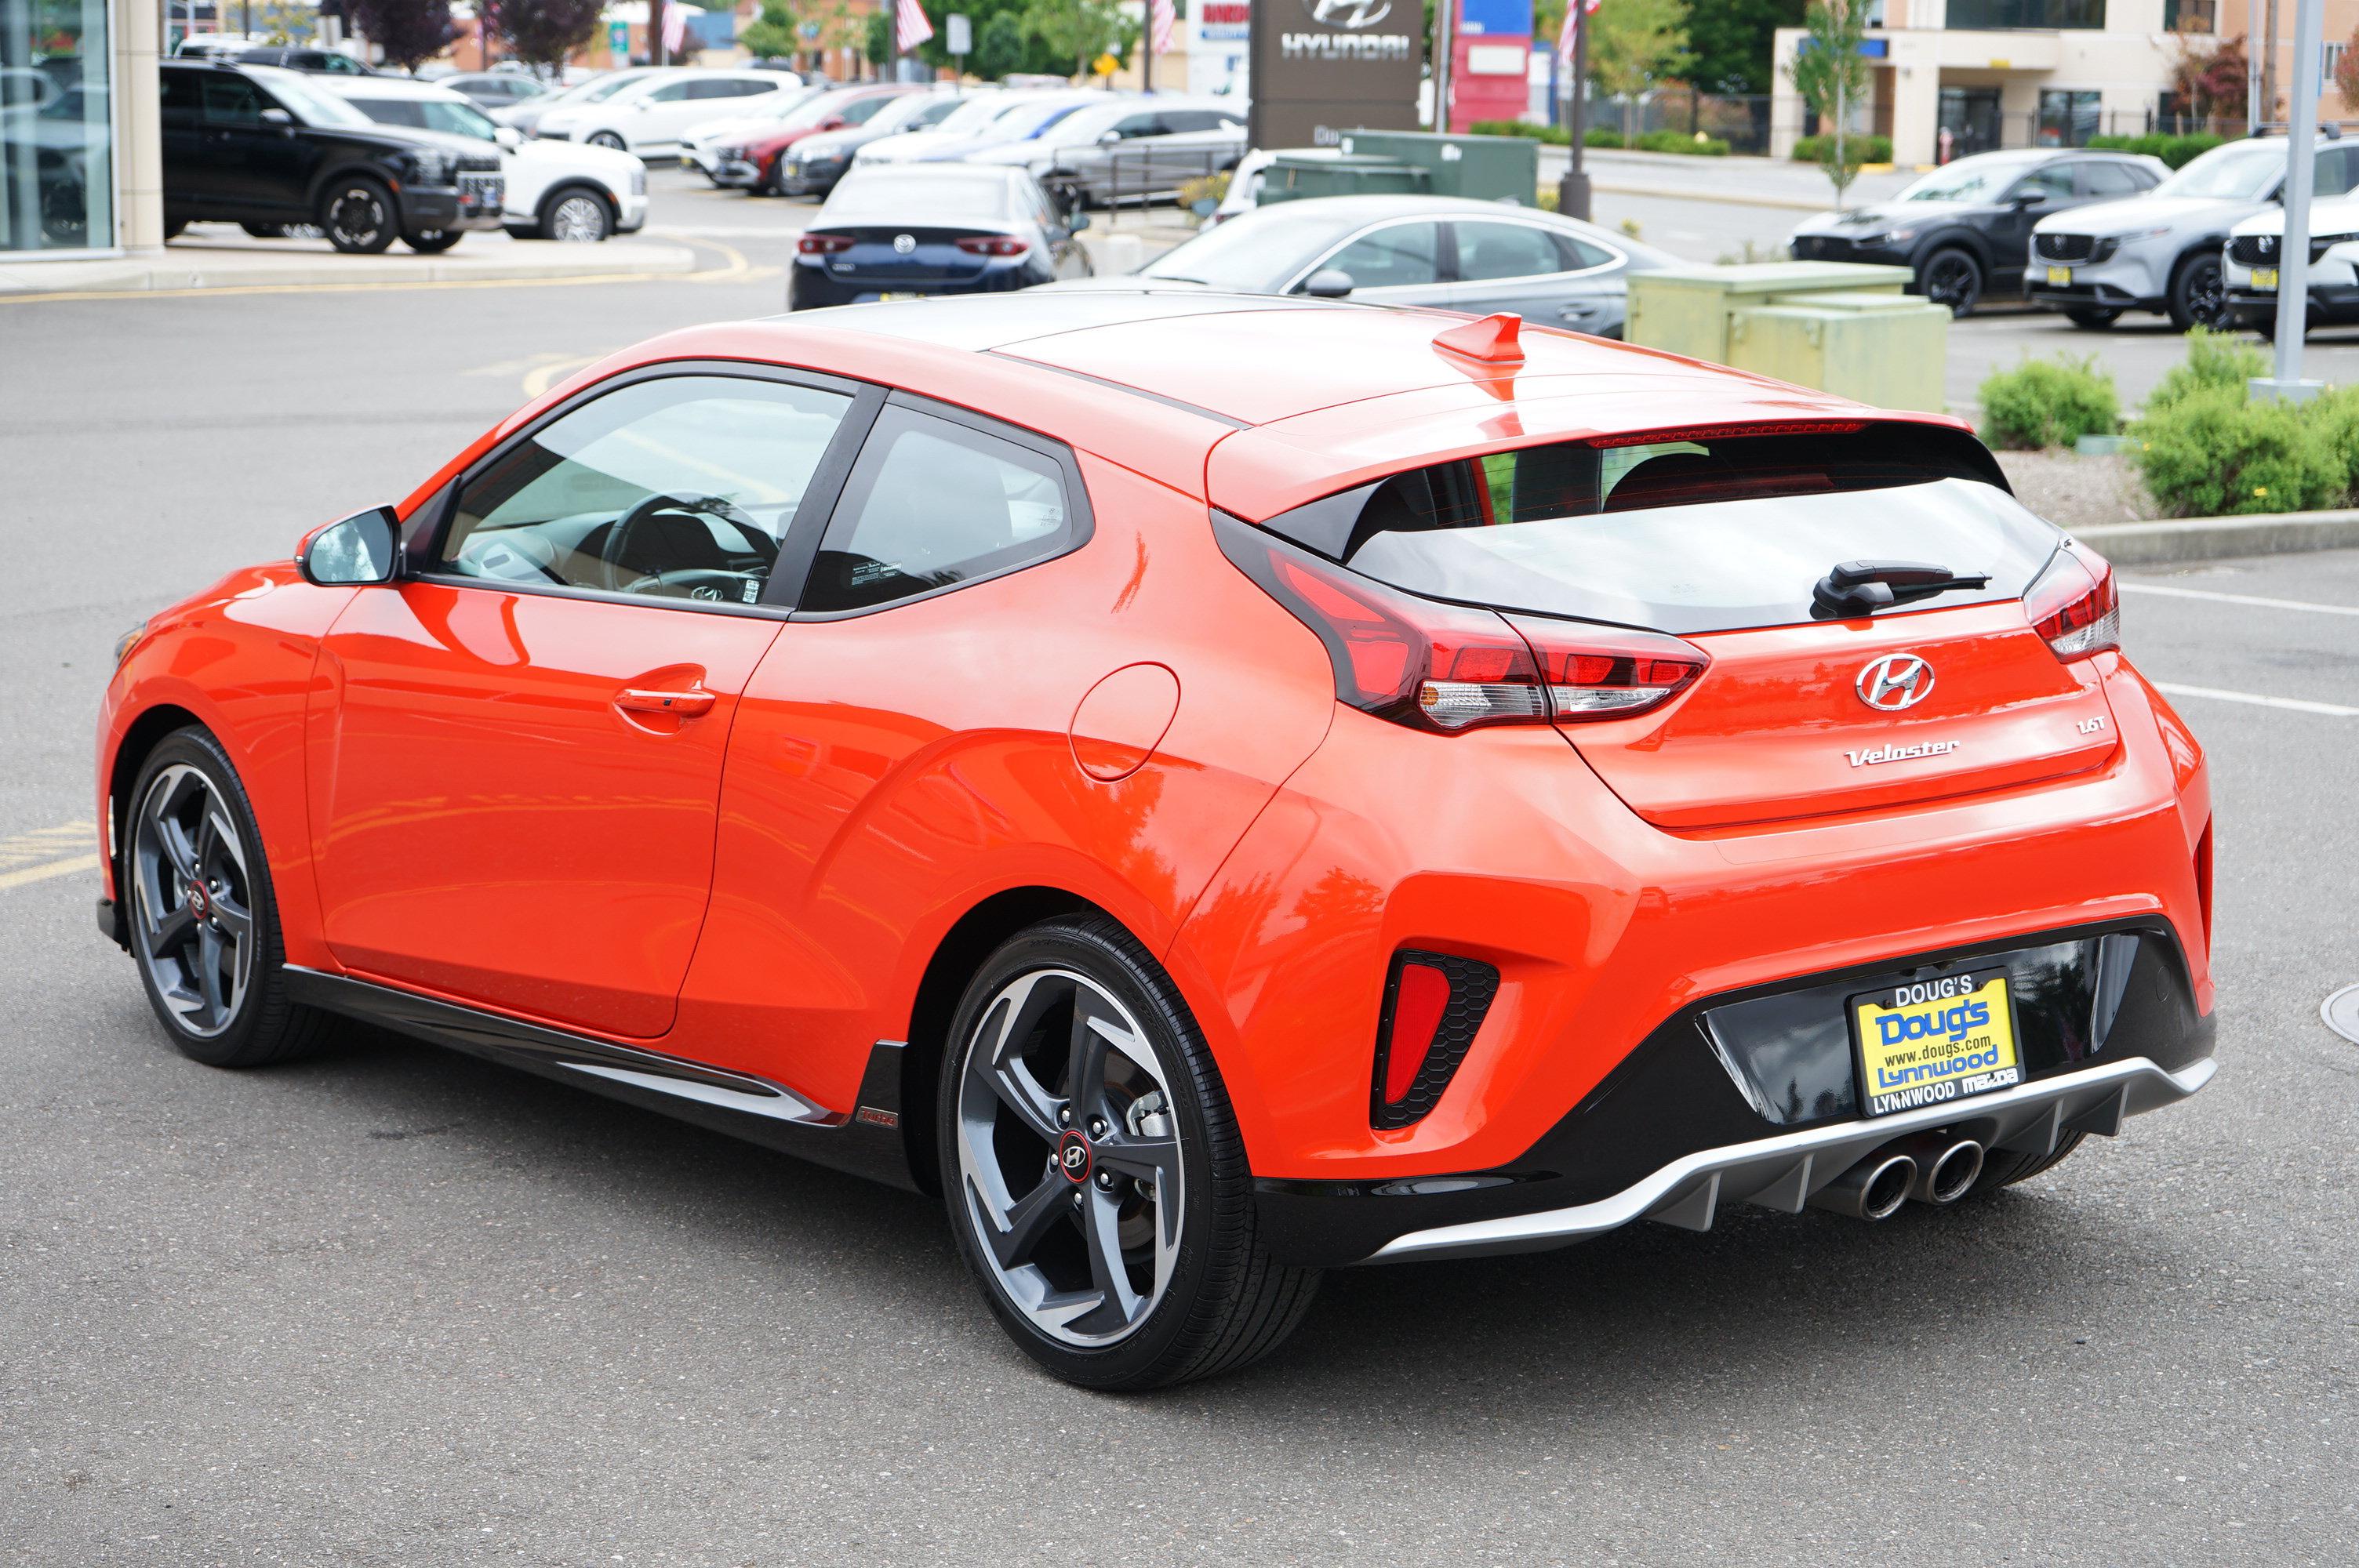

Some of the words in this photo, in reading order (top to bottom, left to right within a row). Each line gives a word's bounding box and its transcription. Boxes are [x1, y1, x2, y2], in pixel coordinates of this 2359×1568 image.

[1281, 33, 1409, 60] HYUNDAI
[1845, 739, 1960, 767] Veloster
[1896, 975, 1972, 1007] DOUG'S
[1877, 1044, 1999, 1089] Lynnwood
[1885, 1036, 1991, 1067] www.dougs.com
[1874, 1081, 1955, 1113] LYNNWOOD
[861, 1109, 896, 1126] Turbo
